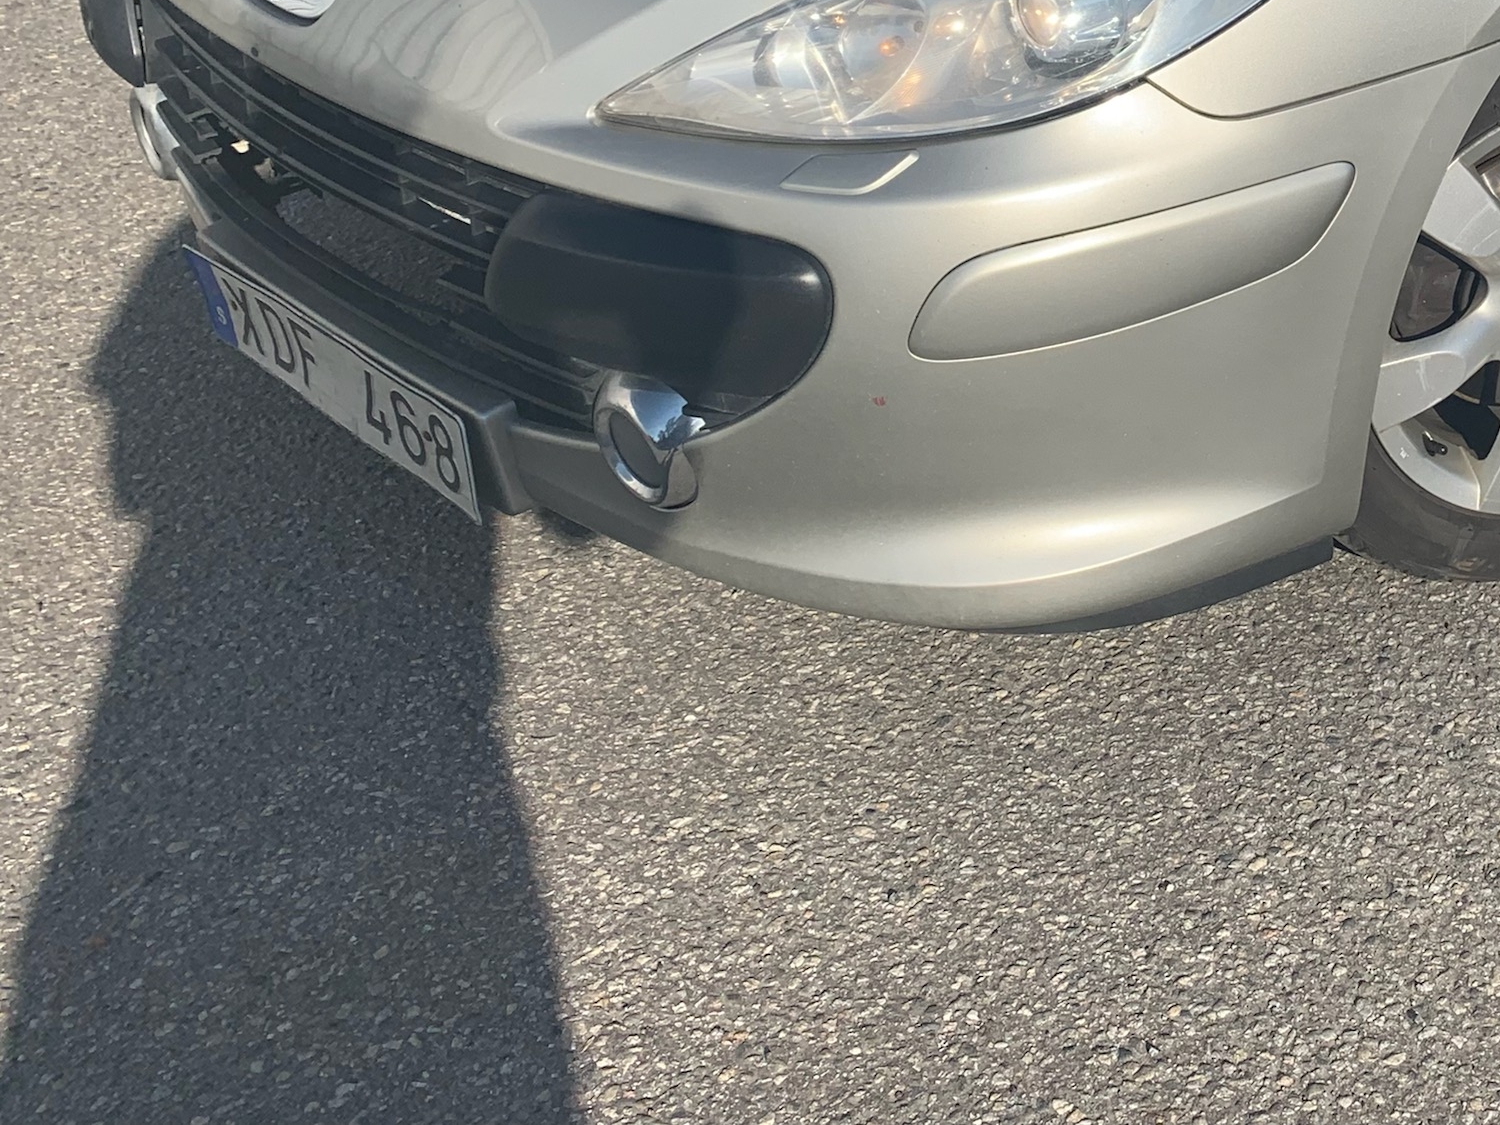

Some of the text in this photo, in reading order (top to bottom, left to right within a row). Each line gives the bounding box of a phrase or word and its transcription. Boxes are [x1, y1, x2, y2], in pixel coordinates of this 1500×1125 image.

[216, 305, 228, 325] S
[220, 277, 461, 493] XDF 468
